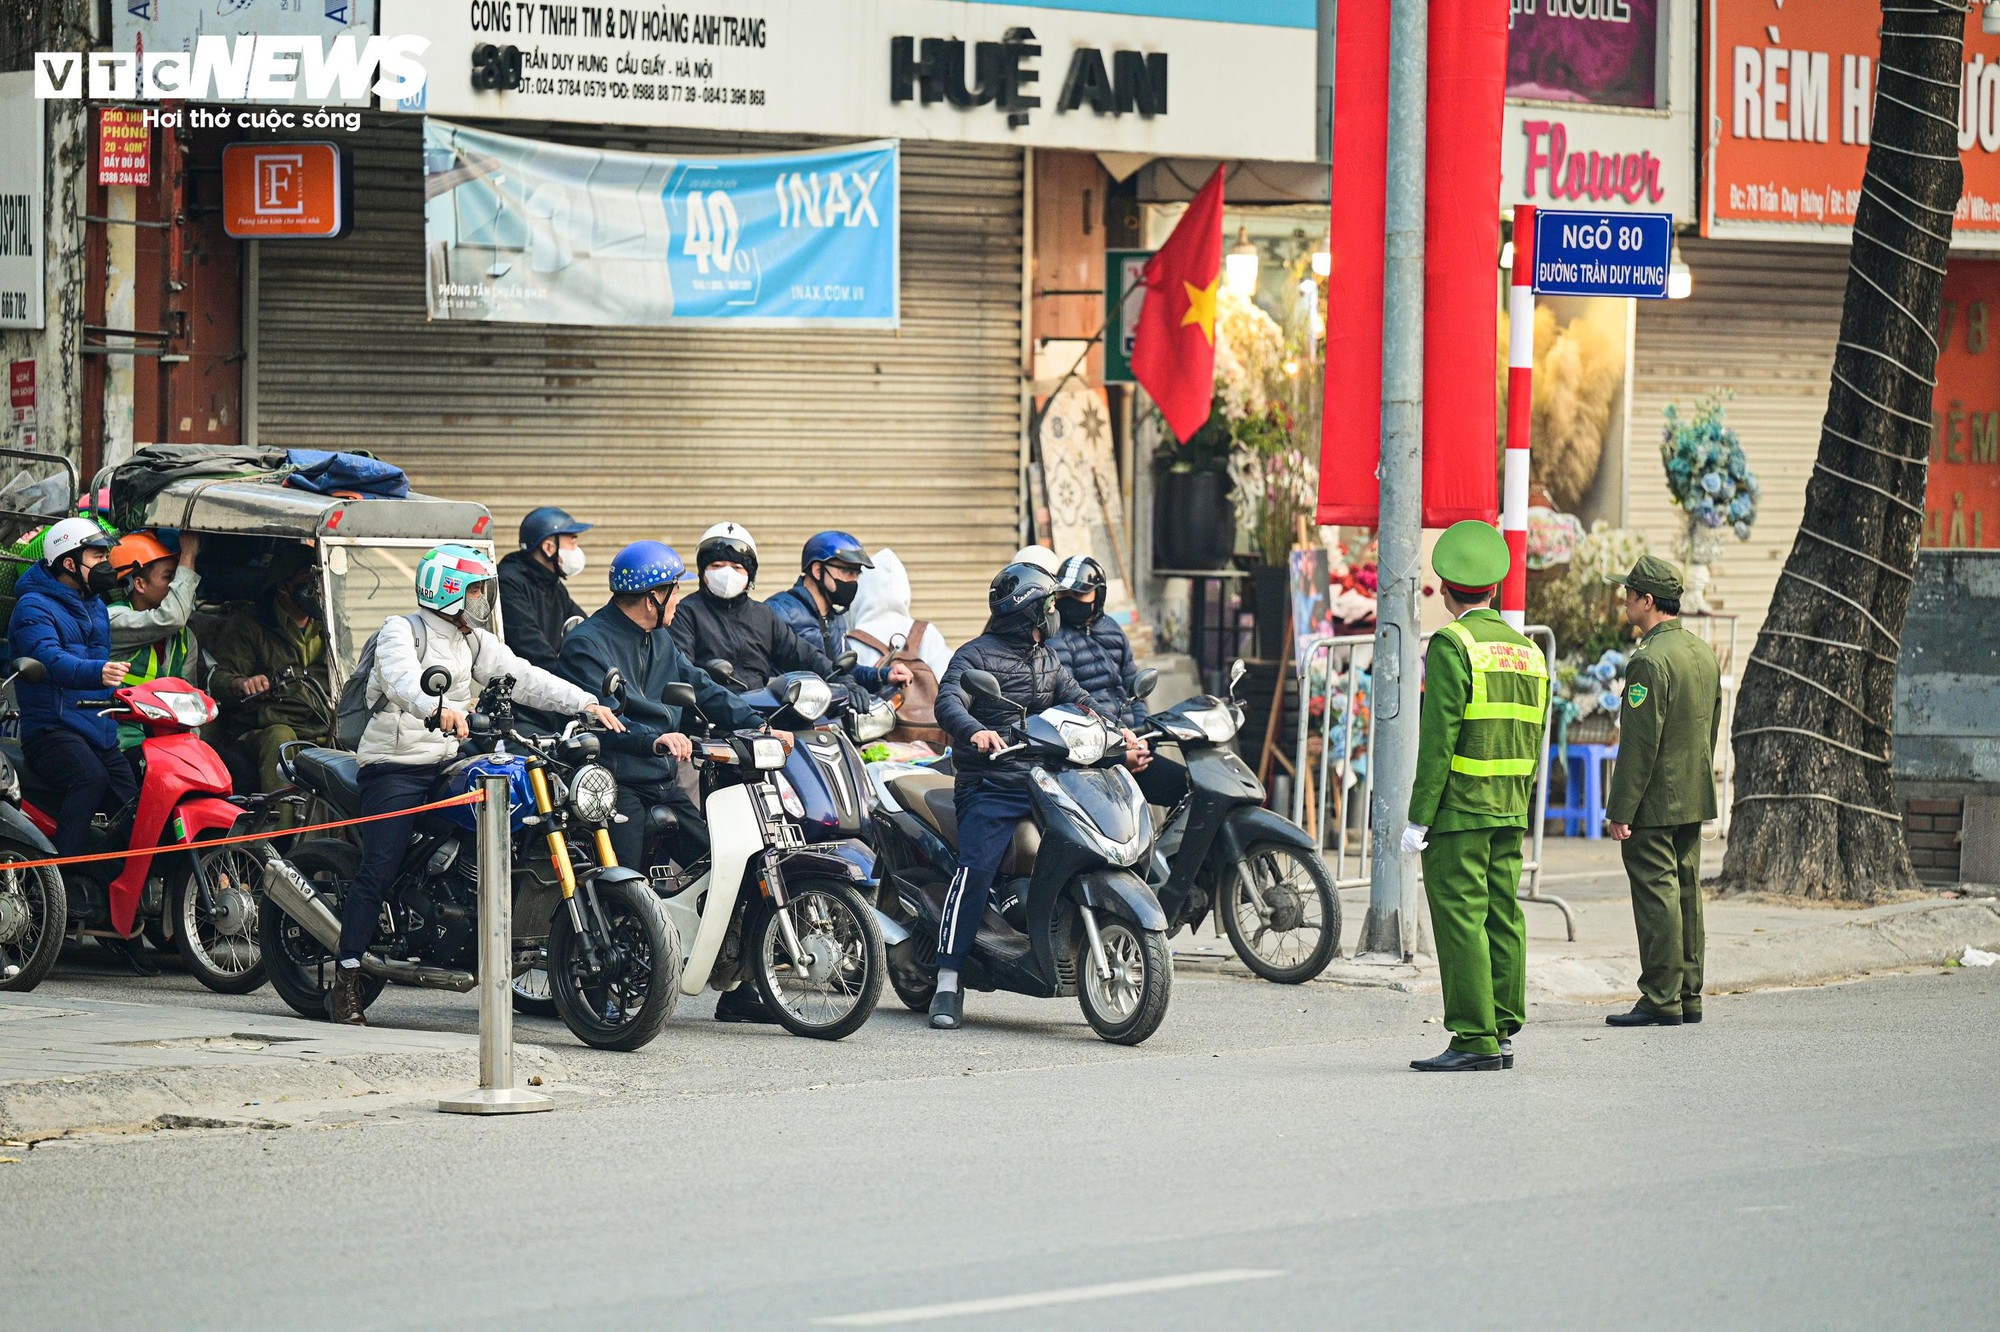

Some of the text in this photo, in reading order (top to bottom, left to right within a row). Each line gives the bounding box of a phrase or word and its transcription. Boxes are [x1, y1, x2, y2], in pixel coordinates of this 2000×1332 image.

[516, 2, 535, 34] TY
[540, 4, 577, 36] TNHH
[582, 7, 602, 38] TM
[605, 7, 616, 38] &
[620, 9, 638, 40] DV
[642, 4, 689, 43] HOÀNG
[692, 14, 721, 45] ANH
[723, 16, 766, 48] TRANG
[471, 43, 522, 90] 80
[552, 53, 574, 71] DUY
[578, 54, 608, 73] HƯNG
[616, 51, 638, 75] CẦU
[641, 53, 666, 76] GIẤY
[675, 57, 691, 78] HÀ
[694, 58, 713, 83] NỘI
[891, 27, 1168, 128] HUỆ AN
[536, 78, 554, 95] 024
[557, 79, 581, 96] 3784
[583, 80, 606, 98] 0579
[671, 85, 682, 102] 77
[685, 86, 696, 102] 39
[1733, 25, 1829, 144] RÈM
[103, 111, 145, 123] CHO THU
[103, 124, 148, 139] PHÒNG
[105, 141, 116, 152] 20
[1523, 119, 1664, 205] Flower
[119, 172, 133, 183] 244
[134, 172, 148, 184] 432
[775, 171, 880, 228] INAX
[1781, 186, 1799, 219] Duy
[1801, 188, 1824, 222] Hưng
[1562, 218, 1643, 251] NGÕ 80
[1539, 258, 1664, 286] ĐƯỜNG TRẦN DUY HƯNG
[438, 281, 470, 297] PHÒNG
